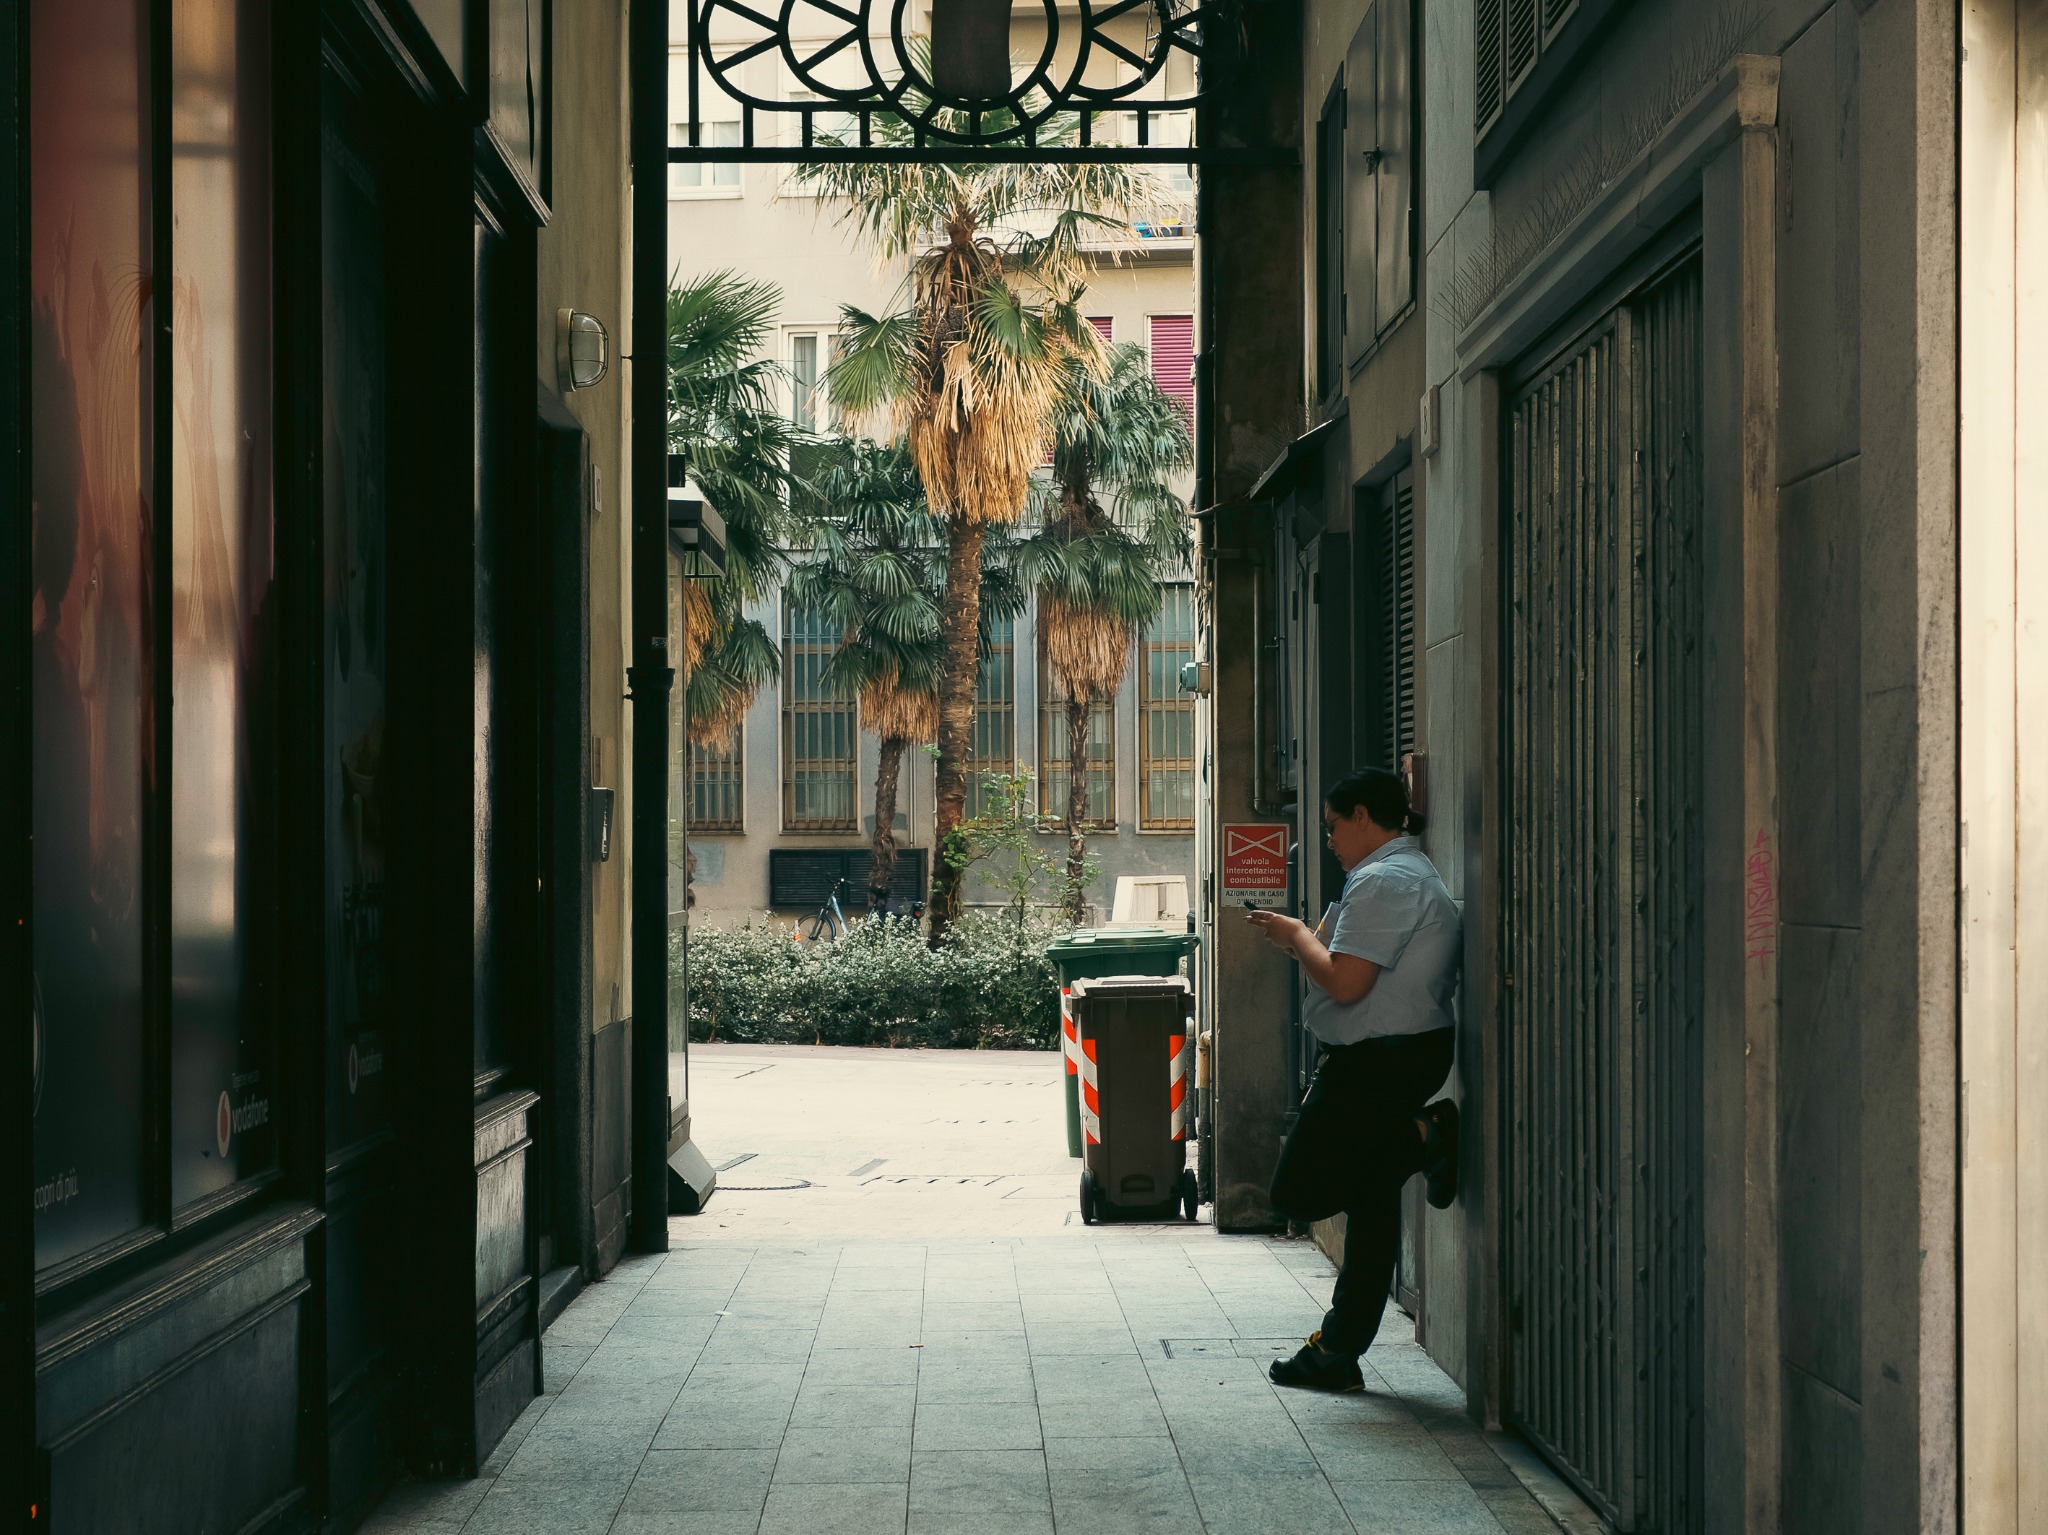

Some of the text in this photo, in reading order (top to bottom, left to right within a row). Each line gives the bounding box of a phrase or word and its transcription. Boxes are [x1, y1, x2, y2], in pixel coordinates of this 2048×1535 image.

[1423, 405, 1428, 434] 8
[1241, 857, 1270, 865] valvola
[1226, 867, 1285, 875] intercettazione
[1229, 876, 1281, 884] combustibile
[1267, 890, 1285, 898] CASO
[358, 1048, 383, 1077] vodafone
[232, 1093, 269, 1135] vodafone
[56, 1172, 64, 1202] di
